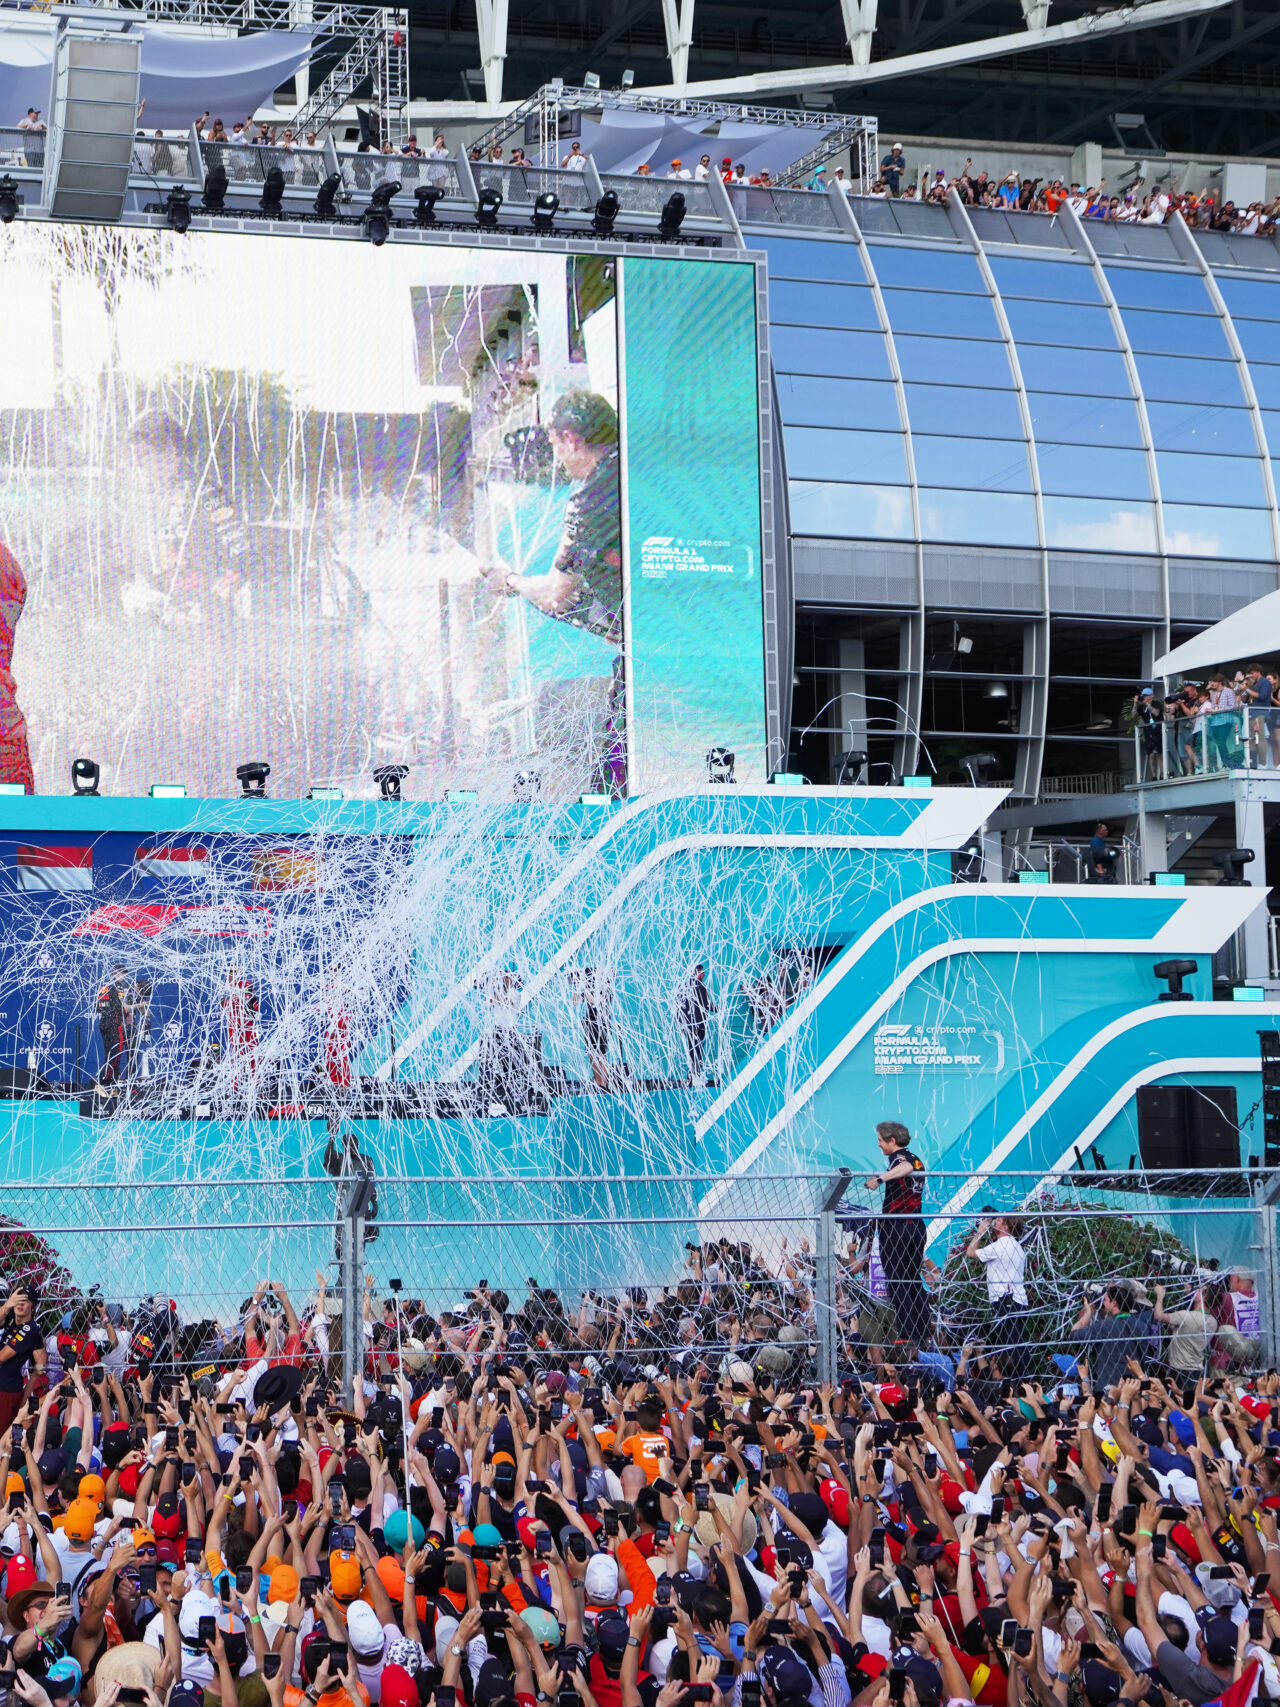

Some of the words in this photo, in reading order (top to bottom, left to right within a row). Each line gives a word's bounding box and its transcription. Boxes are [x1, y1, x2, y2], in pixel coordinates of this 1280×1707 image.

[686, 539, 730, 547] crypto.com
[641, 547, 690, 555] FORMULA
[642, 555, 704, 563] CRYPTO.COM
[642, 562, 673, 570] MIAMI
[926, 1025, 976, 1035] crypto.com
[874, 1037, 930, 1046] FORMULA
[931, 1037, 938, 1045] 1
[874, 1046, 946, 1055] CRYPTO.COM
[875, 1056, 912, 1064] MIAMI
[913, 1056, 953, 1064] GRAND
[954, 1056, 981, 1064] PRIX
[308, 1106, 323, 1114] FIA
